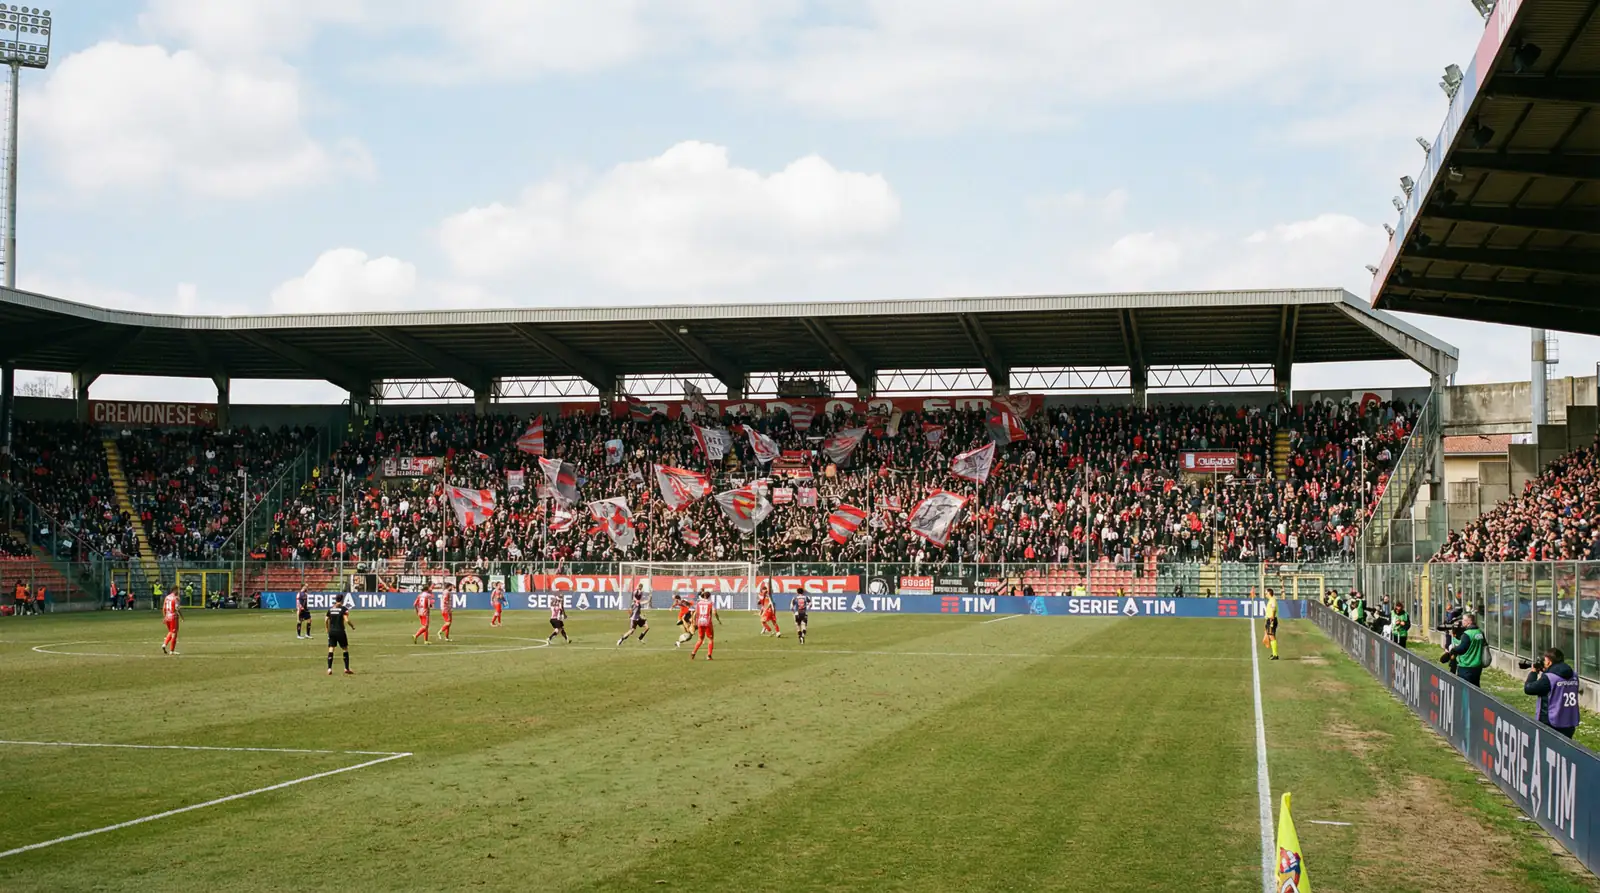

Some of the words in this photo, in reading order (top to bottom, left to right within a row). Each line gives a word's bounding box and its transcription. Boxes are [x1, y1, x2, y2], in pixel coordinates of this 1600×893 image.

[94, 402, 197, 424] CREMONESE
[306, 594, 337, 608] ERIE
[359, 594, 386, 608] TIM
[437, 594, 467, 608] TM
[527, 594, 572, 608] SERE
[871, 597, 901, 611] TIM
[962, 597, 996, 612] TIM
[1068, 599, 1119, 614] SERIE
[1142, 600, 1176, 614] TIM
[1563, 692, 1577, 707] 28
[1439, 678, 1455, 737] TIM
[1494, 715, 1529, 799] SERIE
[1546, 746, 1577, 840] TIM
